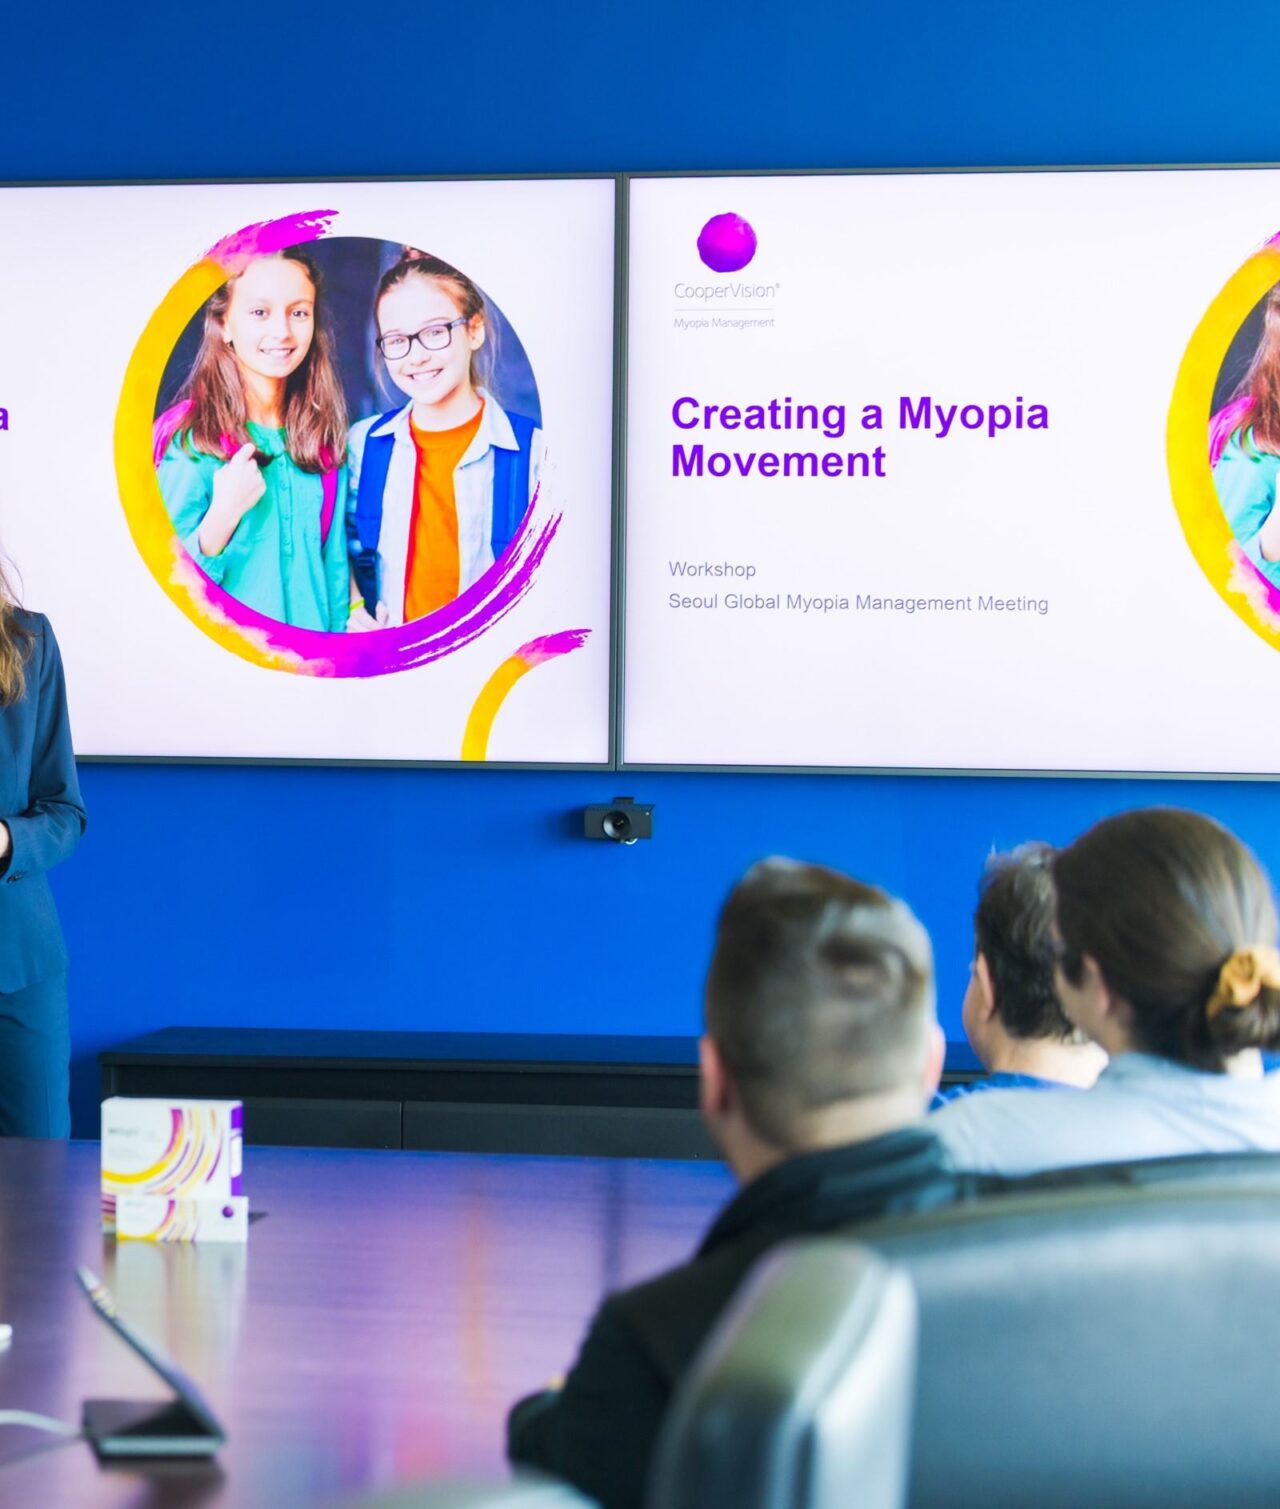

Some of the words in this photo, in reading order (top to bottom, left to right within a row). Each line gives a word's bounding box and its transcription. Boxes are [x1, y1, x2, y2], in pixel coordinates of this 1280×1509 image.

[674, 318, 709, 331] Myopia
[712, 318, 775, 330] Management
[672, 397, 845, 438] Creating
[861, 405, 882, 429] a
[900, 396, 1048, 438] Myopia
[673, 444, 886, 477] Movement
[669, 561, 756, 580] Workshop
[669, 593, 717, 608] Seoul
[725, 594, 779, 609] Global
[787, 594, 849, 613] Myopia
[856, 595, 971, 614] Management
[978, 596, 1048, 615] Meeting
